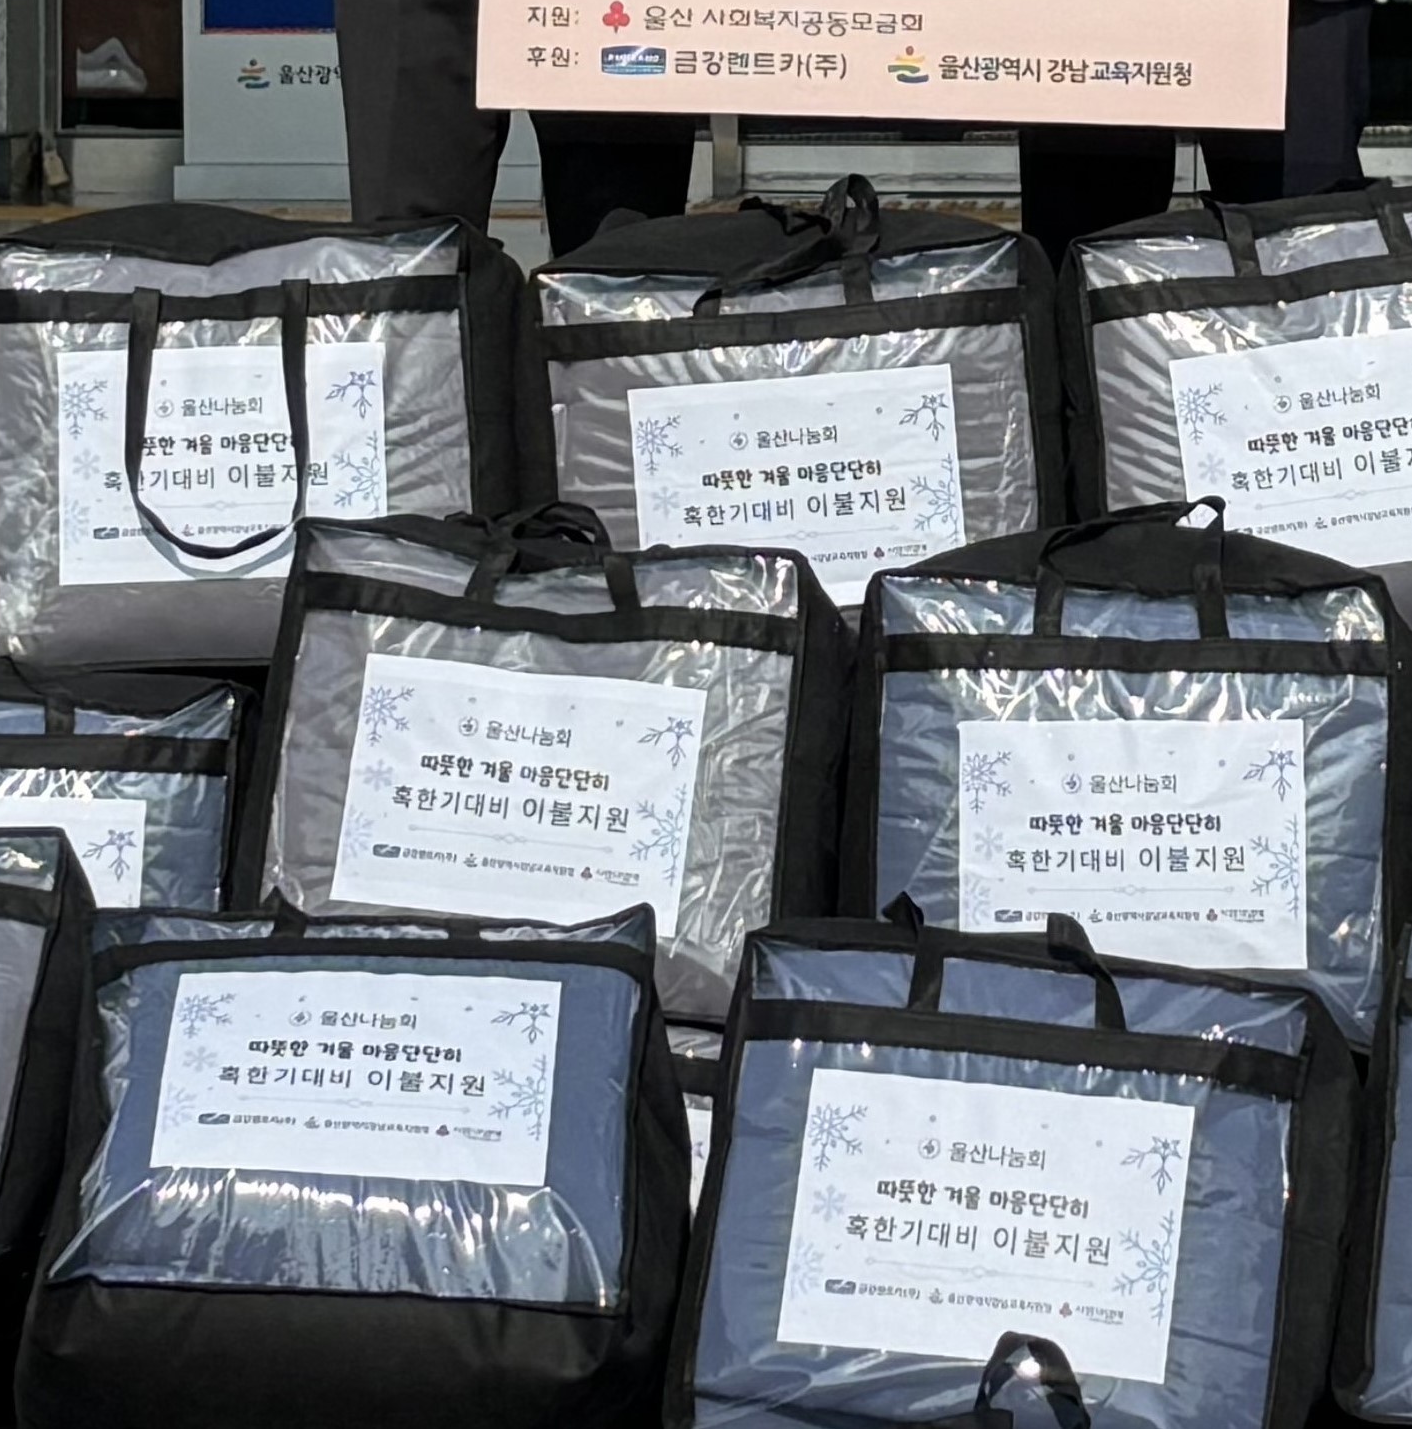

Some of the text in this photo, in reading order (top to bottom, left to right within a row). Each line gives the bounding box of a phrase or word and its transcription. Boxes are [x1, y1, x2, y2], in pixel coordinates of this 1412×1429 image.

[527, 5, 924, 37] 지원: 울산 사회복지공동모금회
[527, 46, 1193, 87] 후원: 금강렌트카(주) 울산광역시 강남교육지원청
[181, 397, 263, 417] 울산나눔회
[1299, 384, 1380, 410] 울산나눔회
[143, 433, 295, 456] 뜻한 겨울 마음단단
[756, 426, 837, 448] 울산나눔회
[1248, 431, 1298, 453] 따뜻한
[1304, 427, 1335, 447] 겨울
[702, 461, 881, 490] 따뜻한 겨울 마음단단히
[1232, 458, 1342, 492] 혹한기대비
[684, 487, 906, 527] 혹한기대비 이불지원
[486, 721, 571, 747] 울산나눔회
[421, 754, 609, 791] 따뜻한 겨울 마음단단히
[1089, 775, 1177, 794] 울산나눔회
[393, 785, 629, 833] 혹한기대비 이불지원
[1030, 814, 1221, 835] 따뜻한 겨울 마음단단히
[1006, 846, 1245, 872] 혹한기대비 이불지원
[320, 1011, 417, 1030] 울산나눔회
[249, 1040, 462, 1062] 따뜻한 겨울 마음단단히
[219, 1065, 485, 1097] 혹한기대비 이불지원
[949, 1142, 1046, 1170] 울산나눔회
[877, 1180, 1088, 1219] 따뜻한 겨울 마음단단히
[846, 1214, 1111, 1266] 혹한기대비 이불지원
